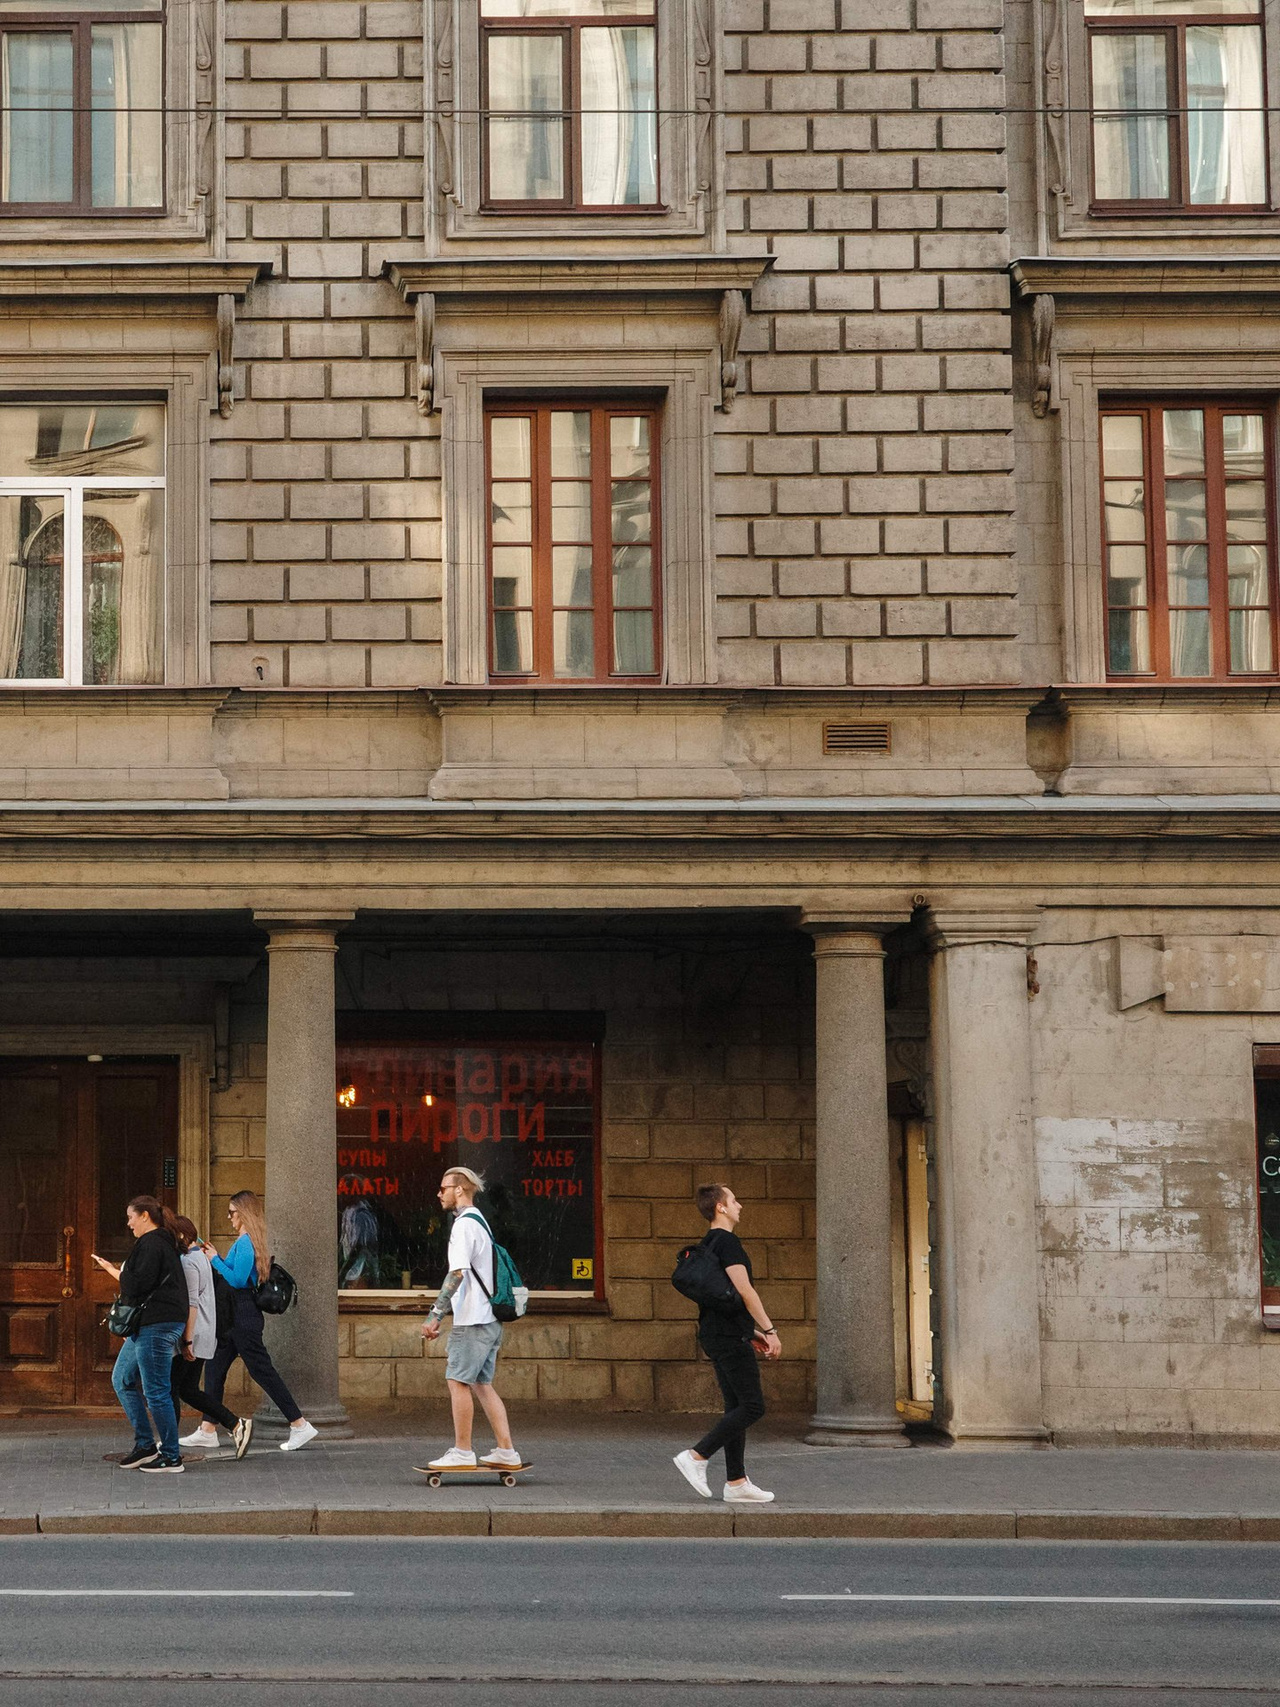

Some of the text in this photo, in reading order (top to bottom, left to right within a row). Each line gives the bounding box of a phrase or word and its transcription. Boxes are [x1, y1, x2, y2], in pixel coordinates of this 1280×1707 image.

[532, 1149, 575, 1167] ХЛЕБ
[337, 1177, 399, 1195] АЛАТЫ
[522, 1179, 582, 1196] ТОРТЫ
